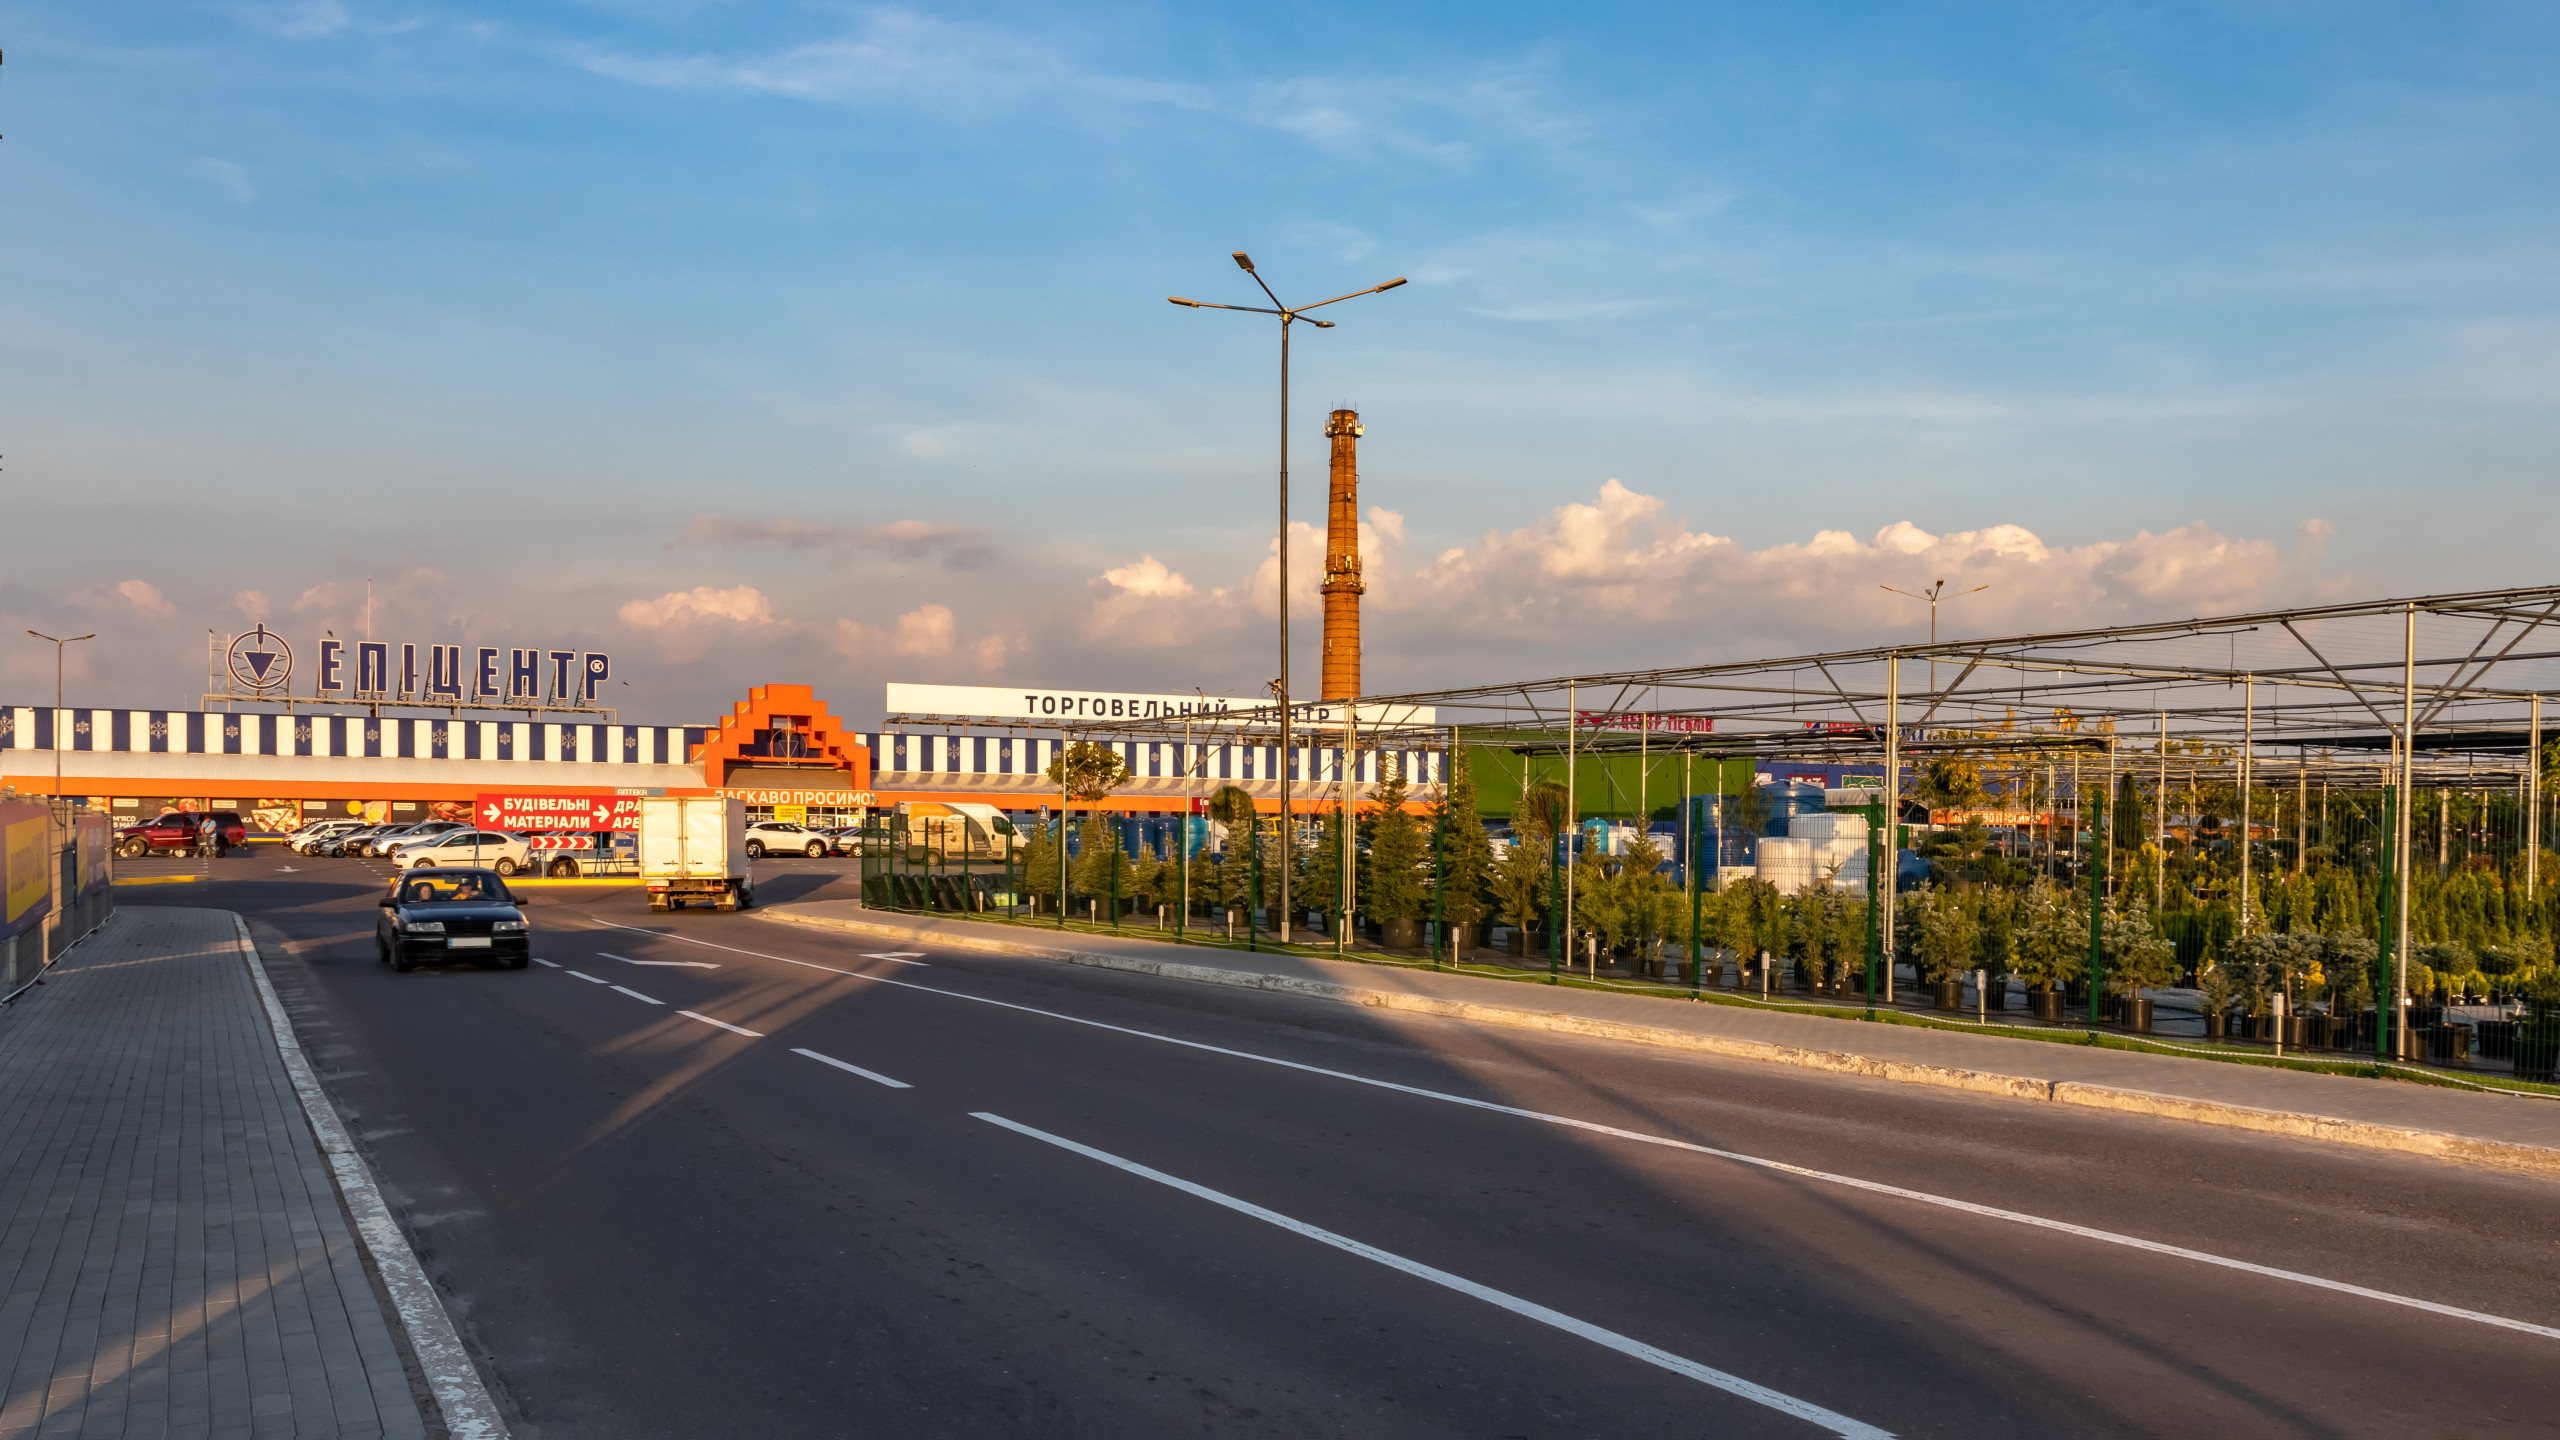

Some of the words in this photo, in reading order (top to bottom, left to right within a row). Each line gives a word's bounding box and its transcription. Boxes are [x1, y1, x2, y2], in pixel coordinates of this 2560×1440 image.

[319, 639, 610, 701] ЕПІЦЕНТР
[1025, 695, 1228, 720] ТОРГОВЕЛЬНИЙ
[504, 798, 590, 813] БУДІВЕЛЬНІ
[504, 816, 590, 828] МАТЕРІАЛИ
